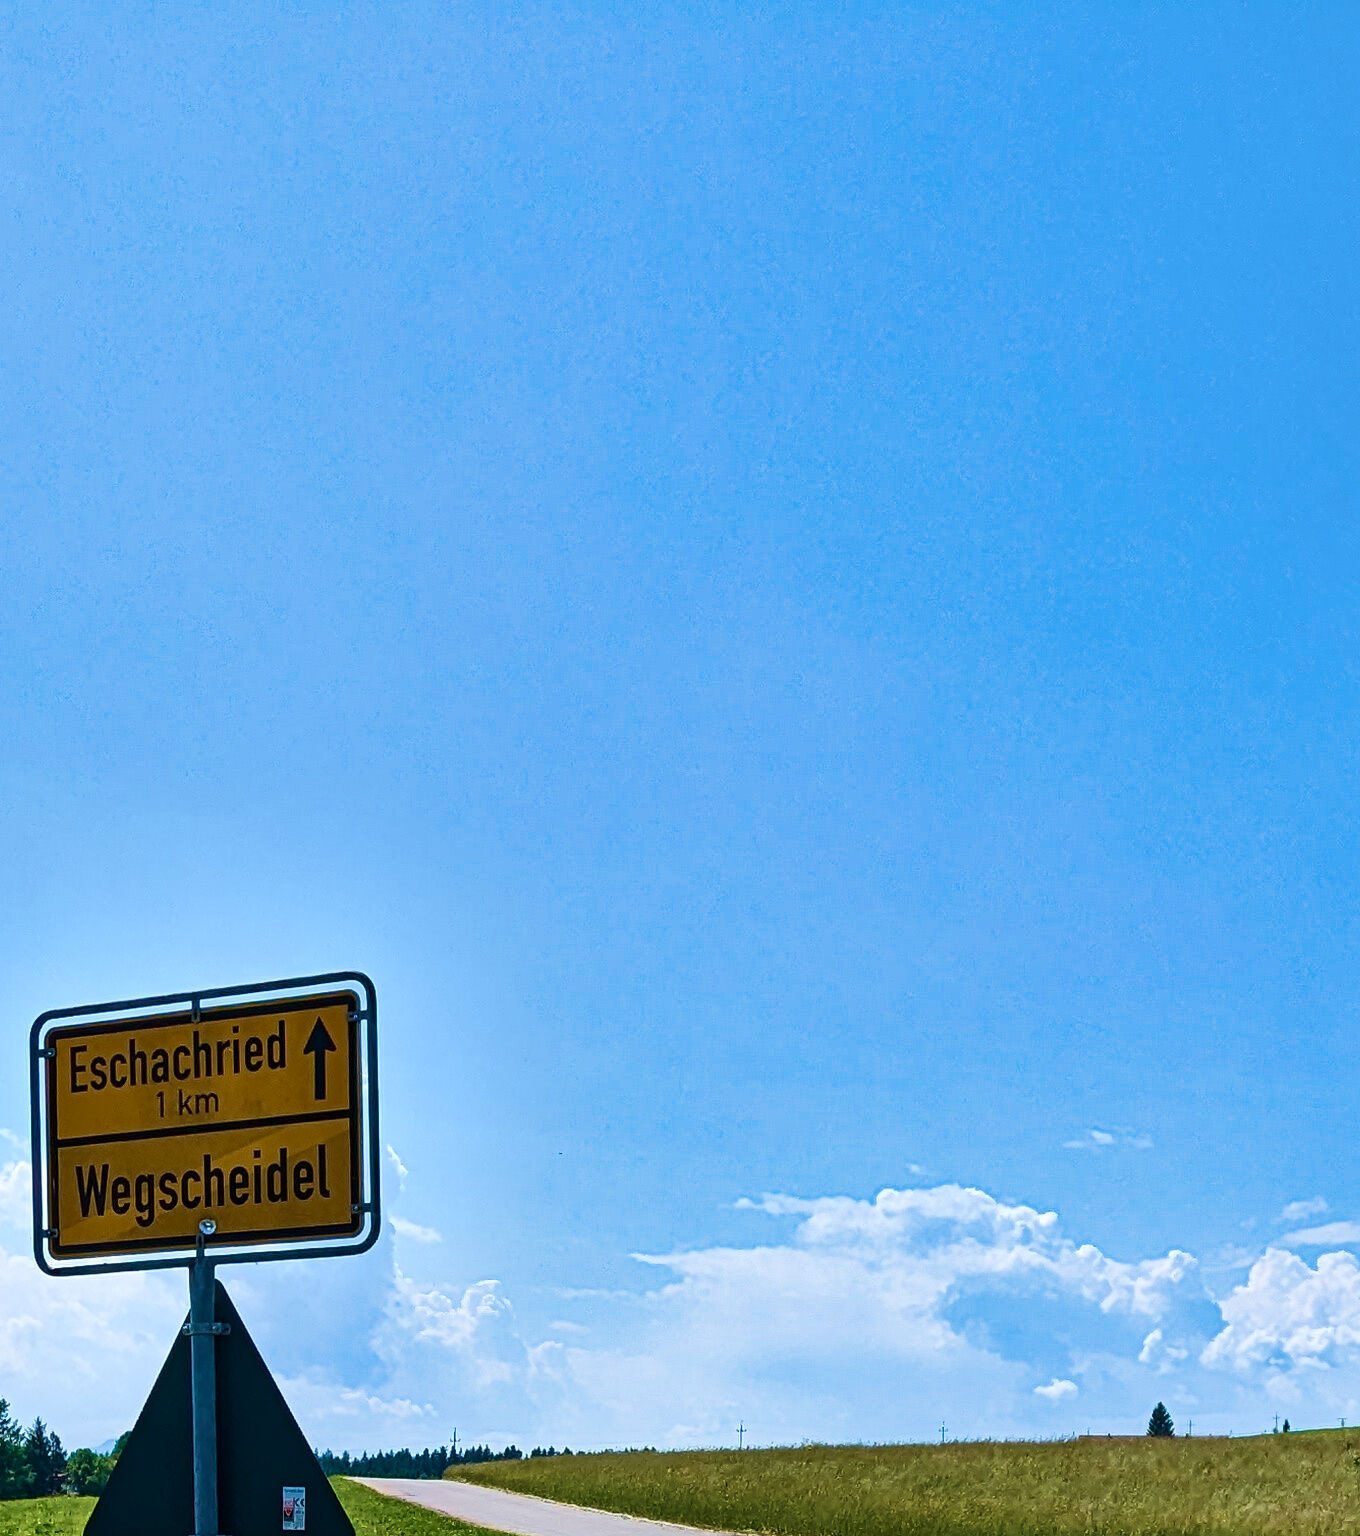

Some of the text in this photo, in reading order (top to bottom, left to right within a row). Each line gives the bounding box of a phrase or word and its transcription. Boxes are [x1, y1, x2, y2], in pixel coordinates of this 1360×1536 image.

[70, 1020, 286, 1093] Eschachried
[156, 1089, 219, 1117] 1 km
[76, 1144, 330, 1227] Wegscheidel
